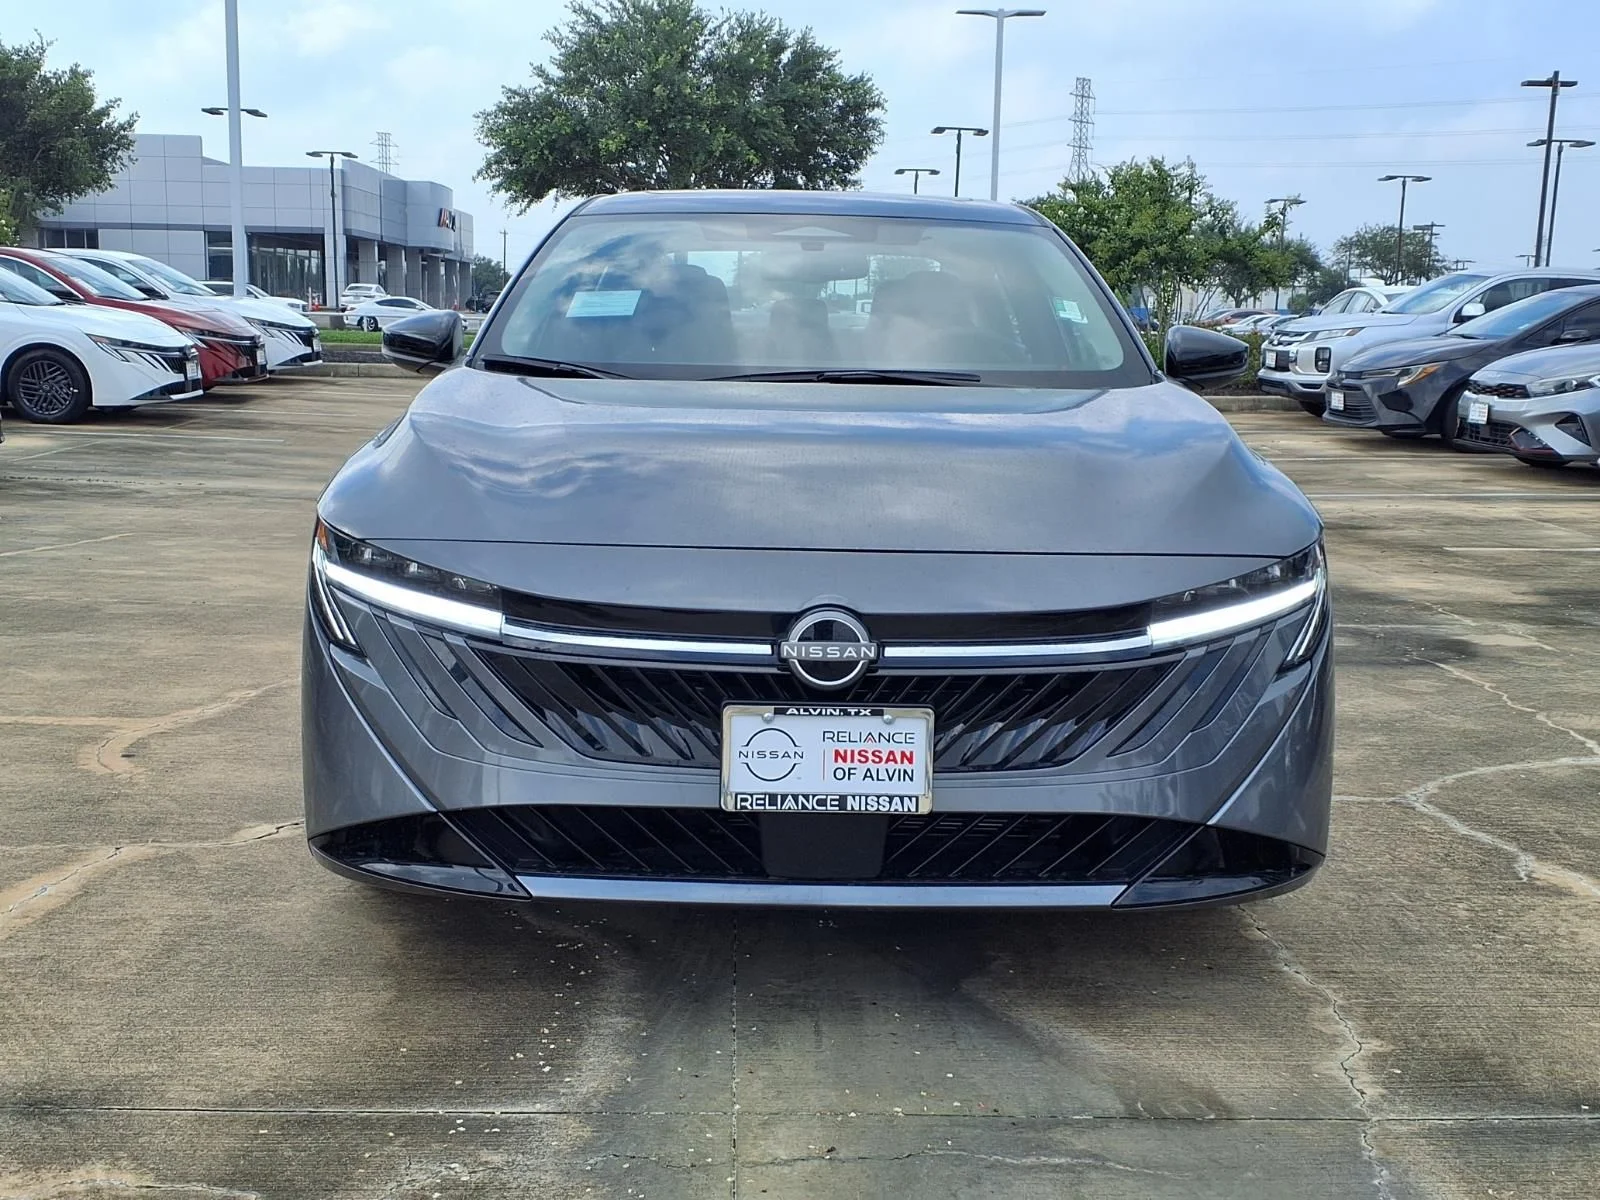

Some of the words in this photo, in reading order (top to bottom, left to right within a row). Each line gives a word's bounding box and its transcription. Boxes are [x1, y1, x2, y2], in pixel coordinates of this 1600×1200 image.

[783, 645, 876, 658] NISSAN
[822, 731, 915, 744] RELIANCE
[738, 750, 804, 760] NISSAN
[834, 749, 914, 765] NISSAN
[833, 767, 858, 781] OF
[863, 768, 914, 782] ALVIN
[737, 794, 839, 811] RELIANCE
[846, 795, 916, 812] NISSAN
